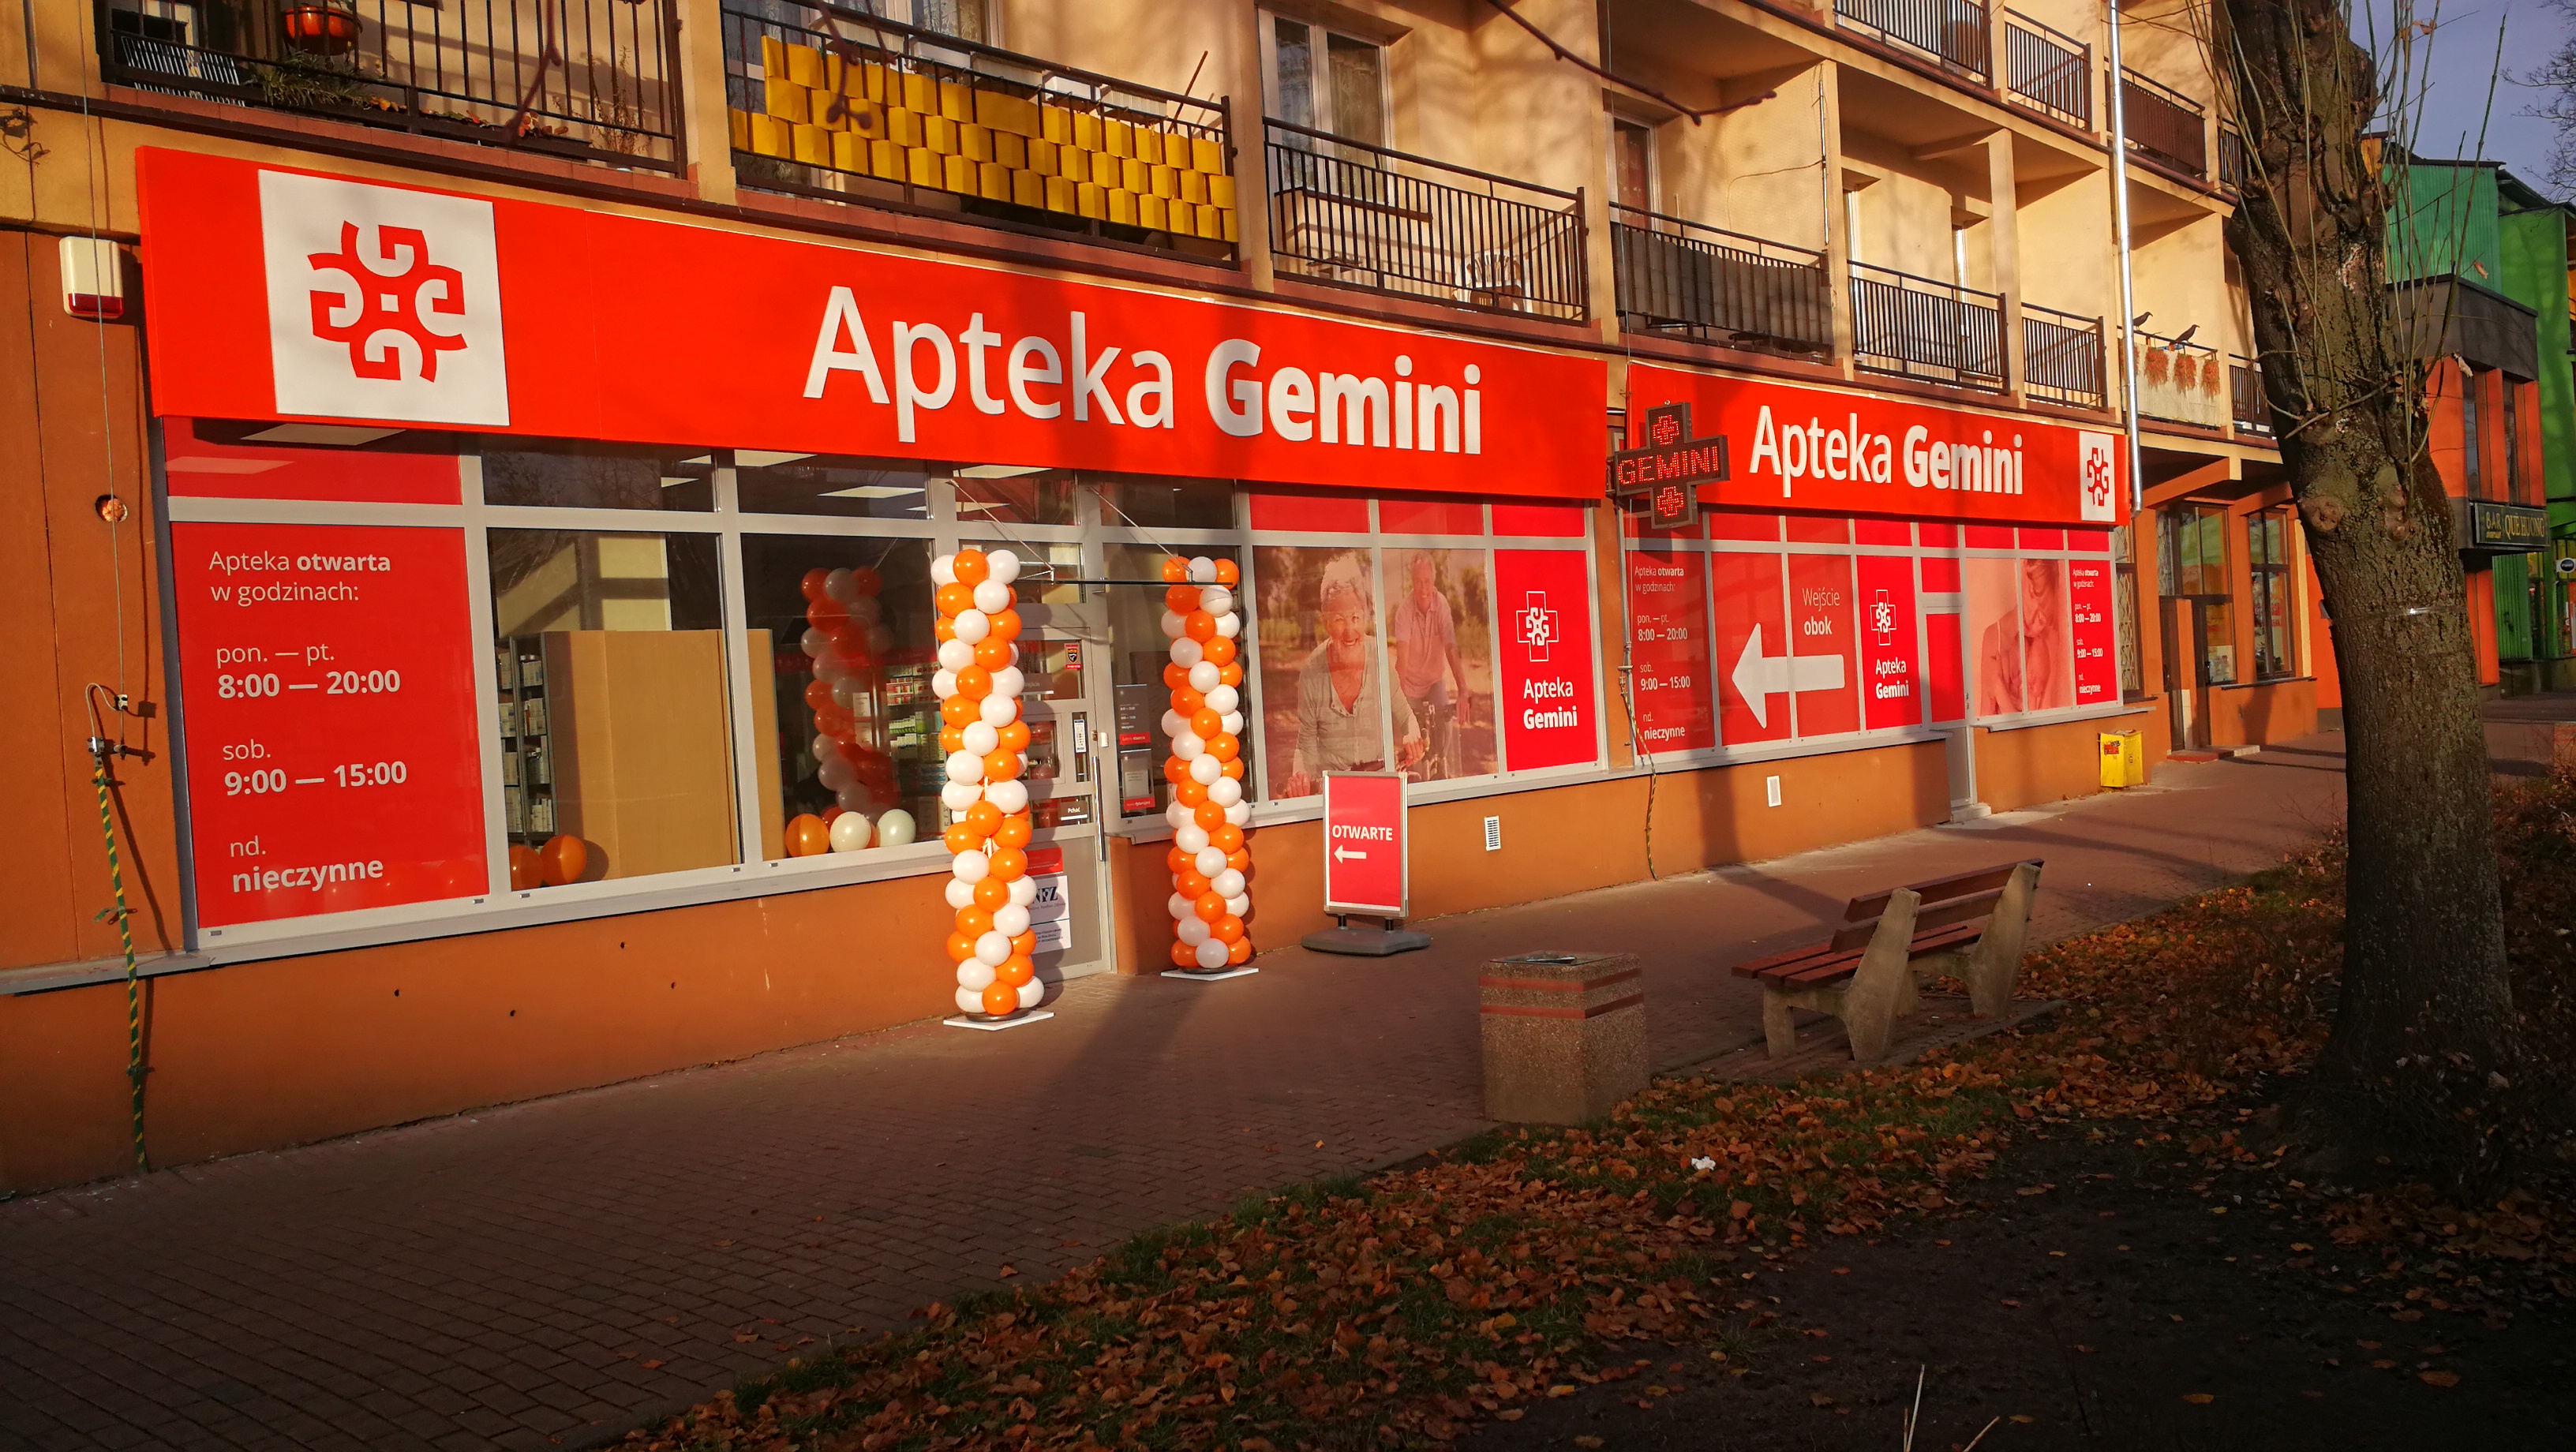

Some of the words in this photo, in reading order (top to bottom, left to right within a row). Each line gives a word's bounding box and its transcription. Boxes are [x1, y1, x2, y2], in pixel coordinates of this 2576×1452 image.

[803, 286, 1174, 443] Apteka
[1205, 339, 1482, 455] Gemini
[1749, 405, 1892, 498] Apteka
[1903, 425, 2024, 495] Gemini
[1618, 446, 1719, 485] GEMINI
[208, 550, 290, 577] Apteka
[296, 553, 391, 572] otwarta
[1634, 566, 1657, 581] Apteka
[1657, 567, 1684, 577] otwarta
[210, 586, 231, 601] w
[238, 581, 360, 608] godzinach:
[1642, 582, 1676, 594] godzinach:
[1802, 586, 1840, 612] Wejście
[1637, 614, 1652, 627] pon.
[1661, 613, 1670, 626] pt.
[1803, 616, 1833, 636] obok
[2075, 613, 2085, 623] 8:00
[1638, 628, 1655, 642] 8:00
[1667, 627, 1688, 641] 20:00
[216, 647, 268, 669] pon.
[306, 643, 335, 667] pt.
[1640, 663, 1654, 673] sob.
[1875, 657, 1907, 679] Apteka
[218, 673, 280, 699] 8:00
[326, 669, 401, 694] 20:00
[1523, 676, 1574, 704] Apteka
[1641, 677, 1658, 691] 9:00
[1669, 675, 1691, 689] 15:00
[1875, 679, 1909, 699] Gemini
[1523, 705, 1578, 730] Gemini
[1642, 712, 1654, 722] nd.
[1644, 726, 1686, 742] nieczynne
[223, 739, 271, 761] sob.
[224, 769, 287, 796] 9:00
[333, 761, 407, 788] 15:00
[1331, 825, 1393, 841] OTWARTE
[230, 835, 267, 858] nd.
[232, 859, 384, 893] nieczynne
